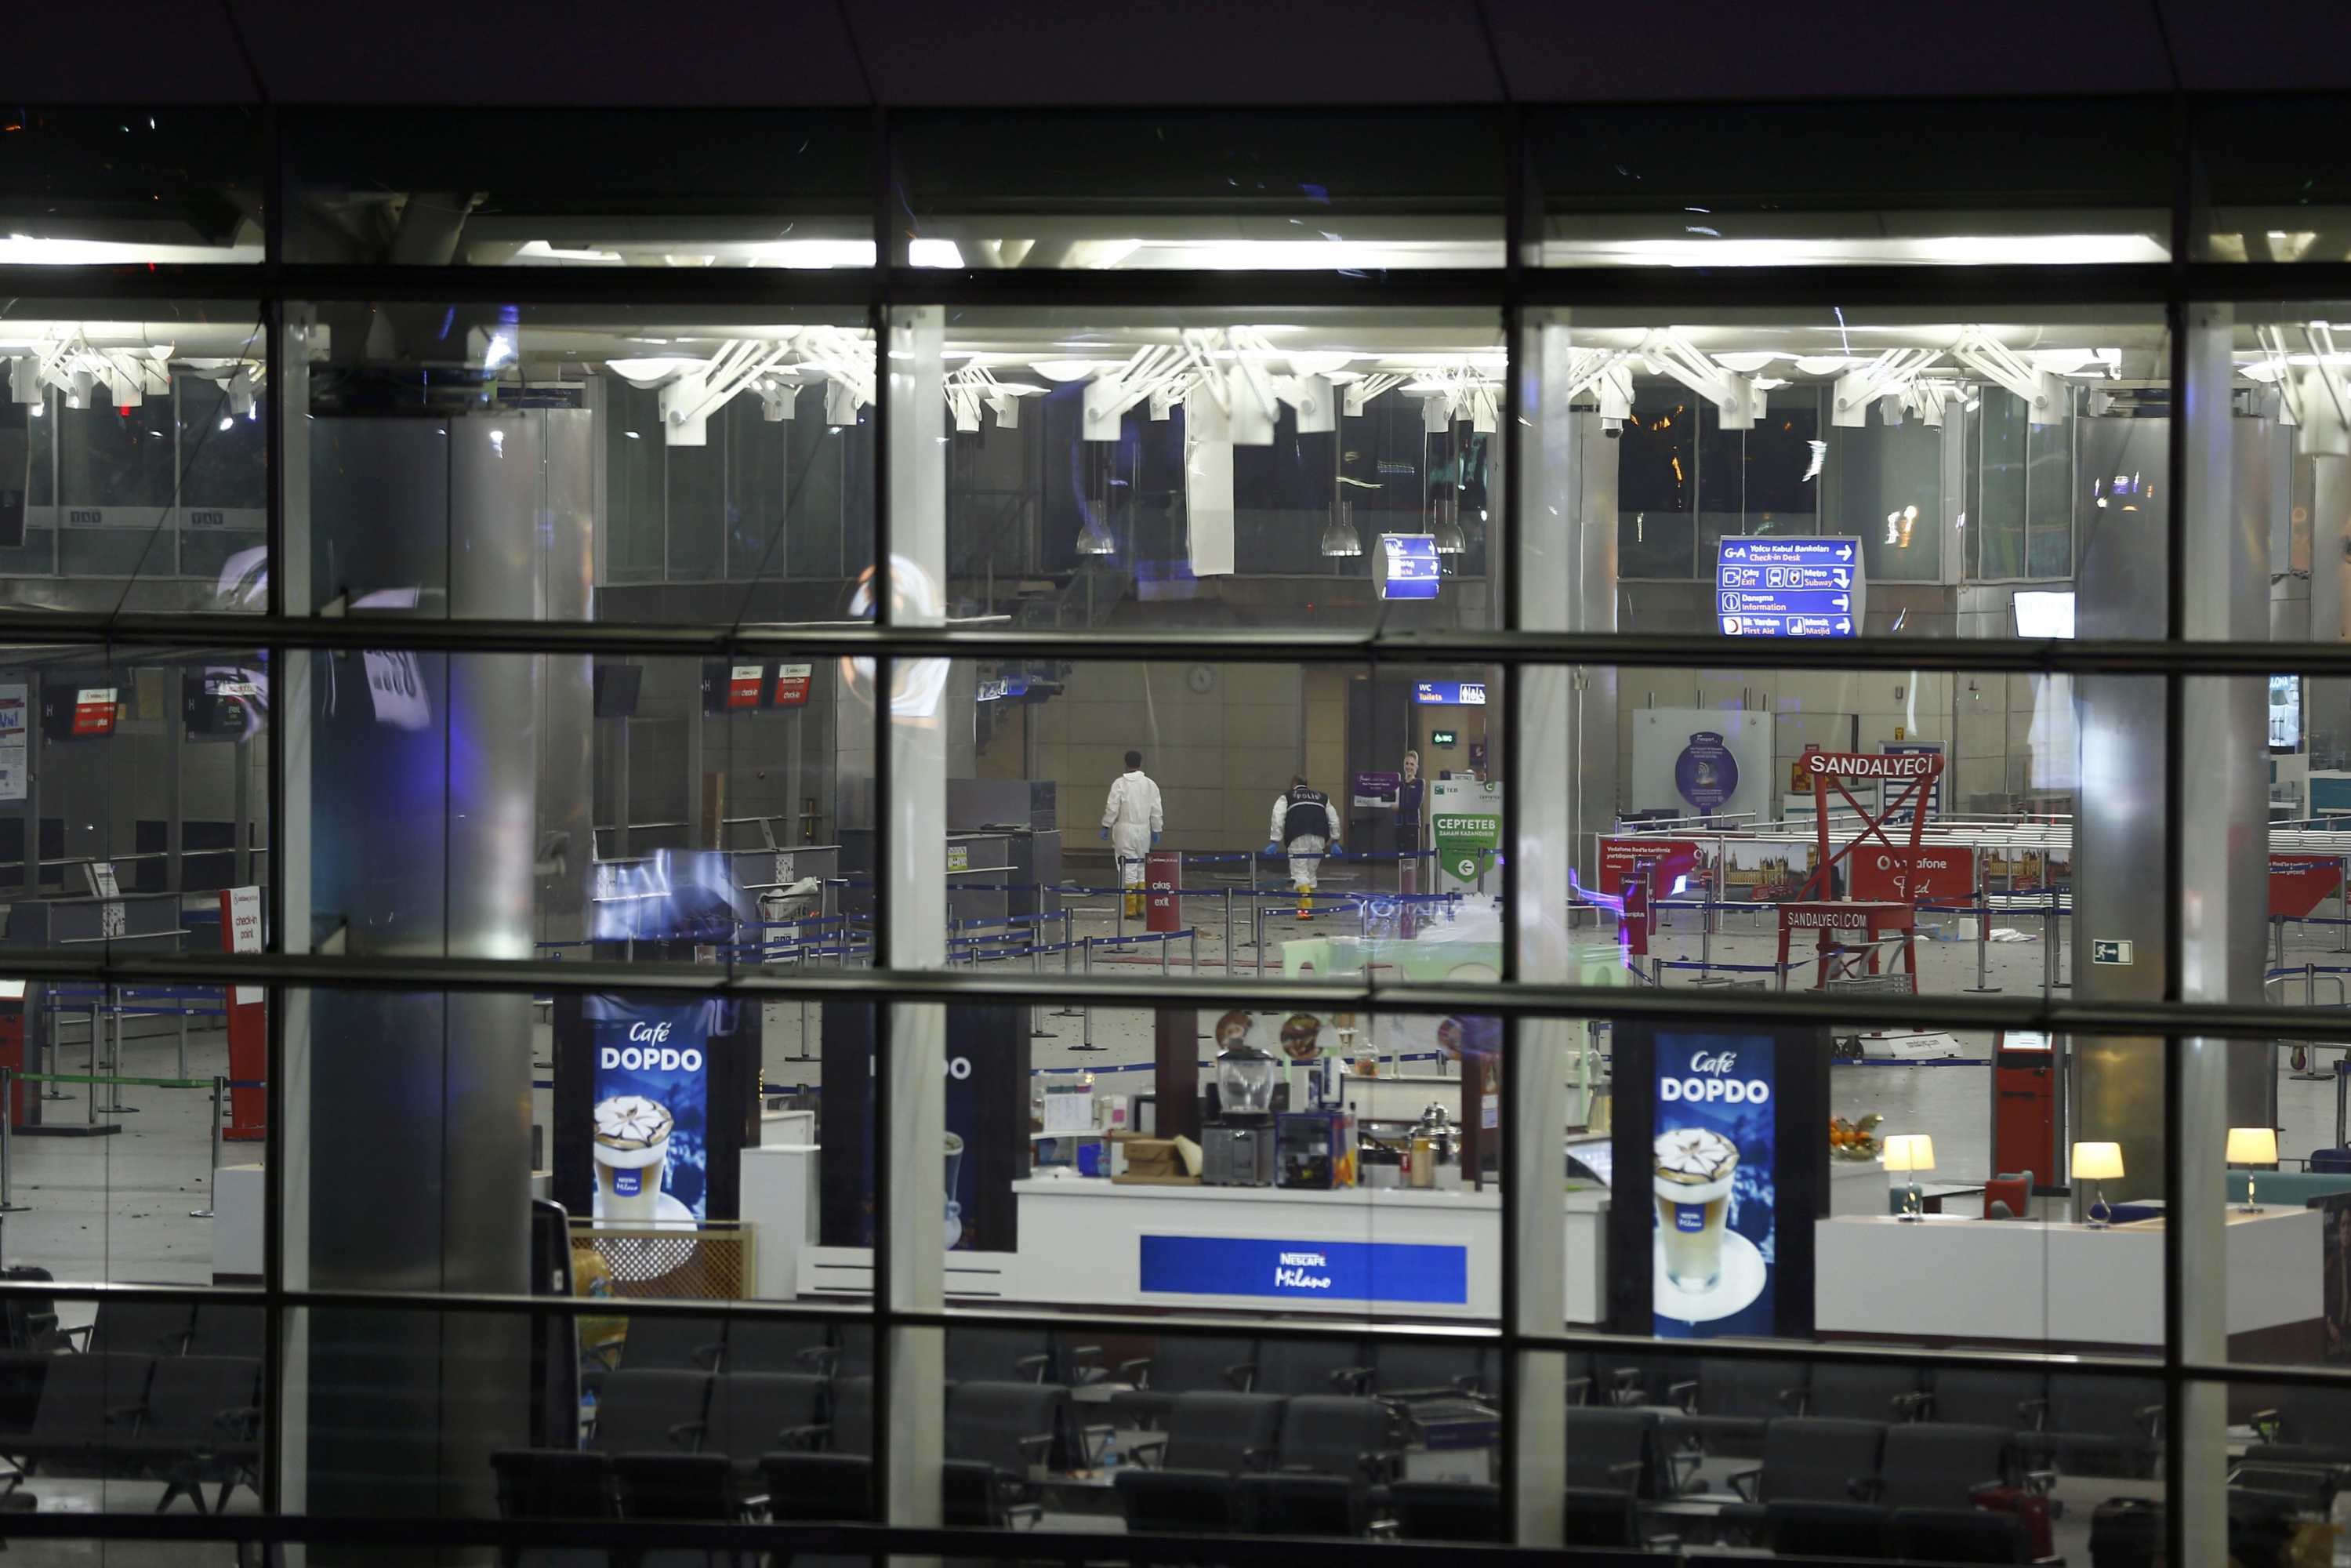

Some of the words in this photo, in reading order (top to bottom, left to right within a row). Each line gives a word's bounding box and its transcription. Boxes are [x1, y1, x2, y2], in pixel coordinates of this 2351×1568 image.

[1725, 547, 1747, 558] G-A
[1750, 554, 1781, 562] Check-in
[1805, 579, 1833, 587] Subway
[1742, 594, 1774, 603] Danışma
[1419, 693, 1443, 702] Toilets
[1809, 754, 1933, 775] SANDALYECİ
[1438, 818, 1496, 829] CEPTETEB
[1155, 897, 1170, 907] exit
[236, 915, 258, 926] check-in
[240, 928, 254, 940] point
[629, 1021, 673, 1047] Café
[600, 1047, 703, 1073] DOPDO
[1689, 1050, 1737, 1078] Café
[1660, 1076, 1770, 1105] DOPDO
[1275, 1266, 1331, 1289] Milano
